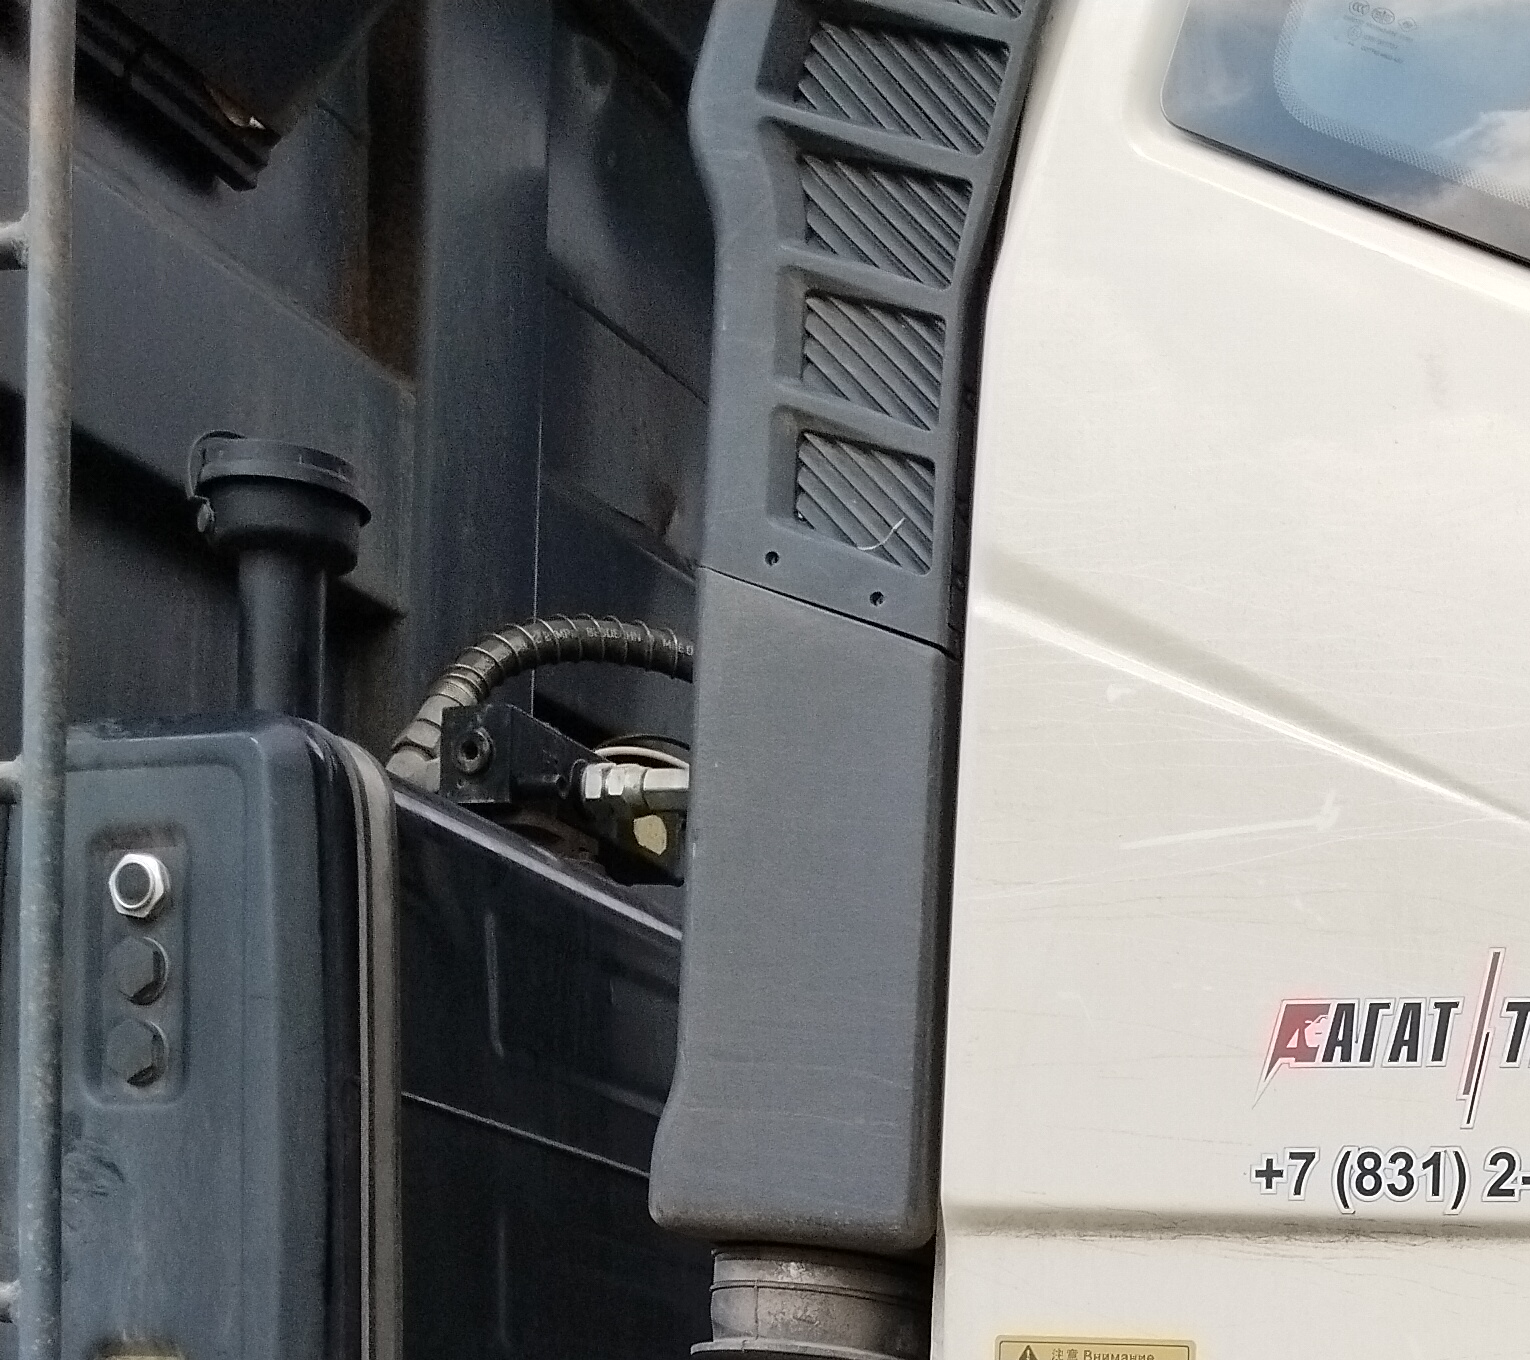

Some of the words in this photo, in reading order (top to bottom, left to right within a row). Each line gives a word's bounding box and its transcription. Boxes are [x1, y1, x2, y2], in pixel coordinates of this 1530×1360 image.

[1320, 1000, 1461, 1065] АГАТ
[1255, 1151, 1316, 1197] +7
[1335, 1150, 1468, 1211] (831)
